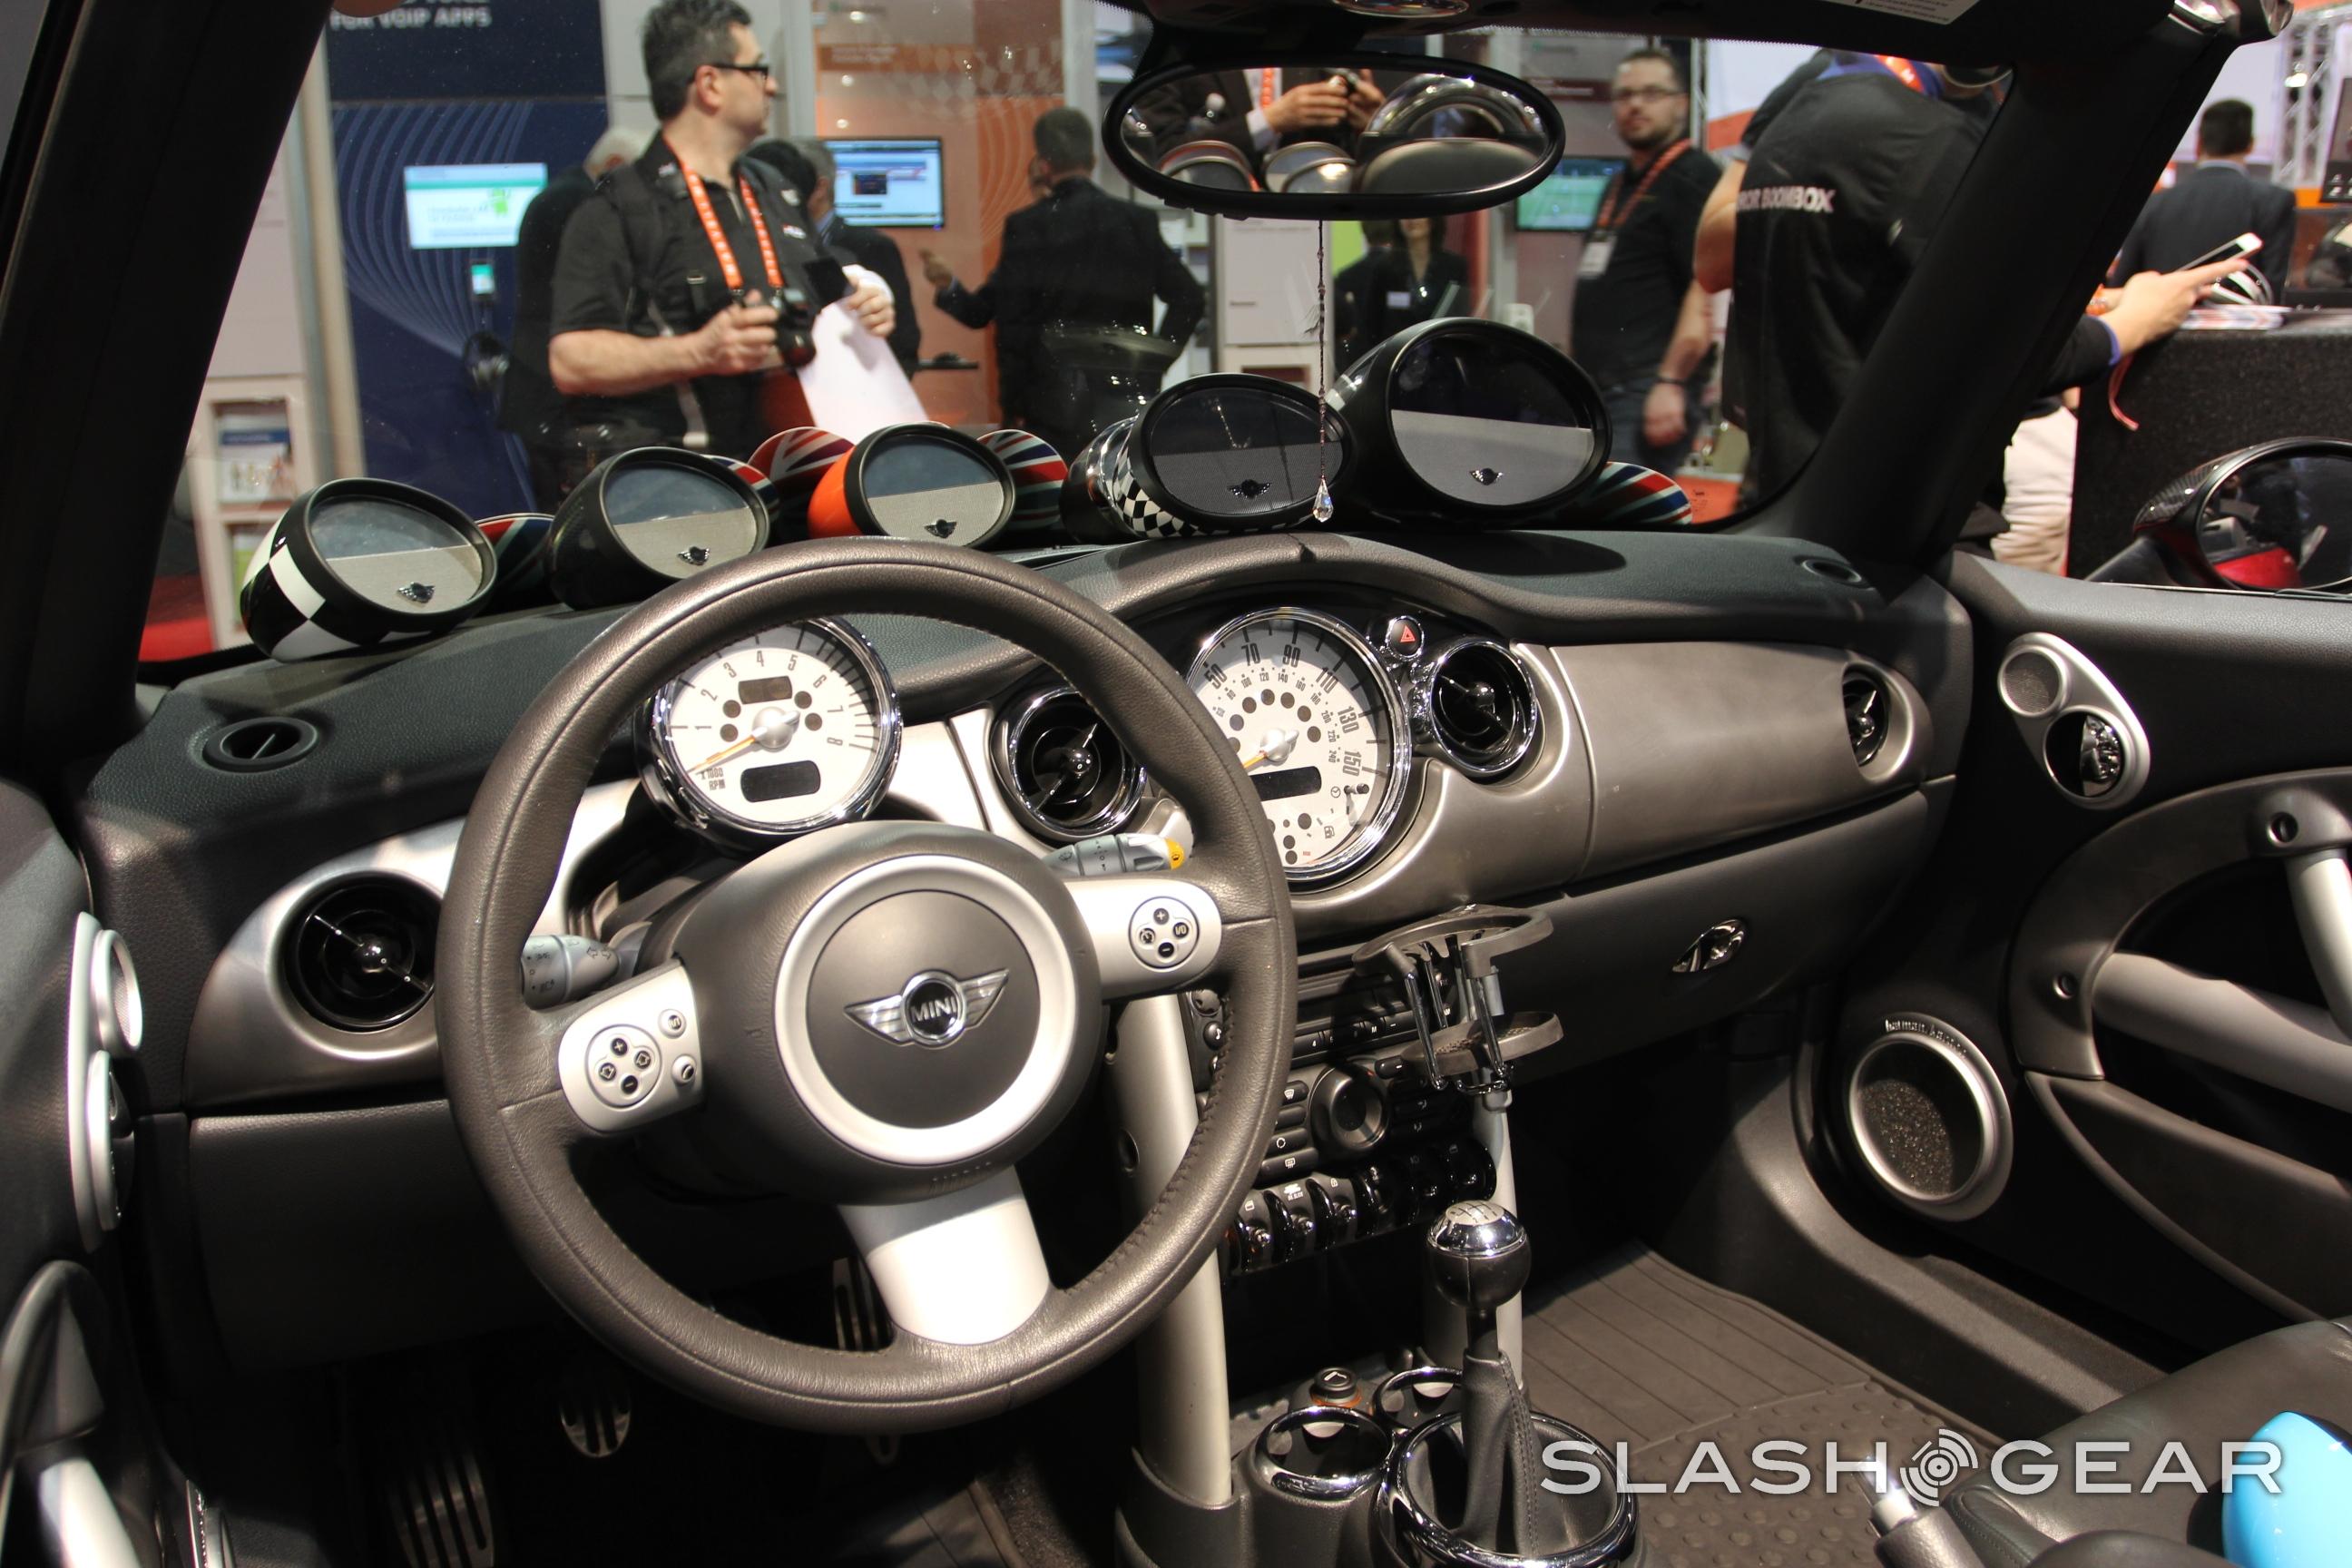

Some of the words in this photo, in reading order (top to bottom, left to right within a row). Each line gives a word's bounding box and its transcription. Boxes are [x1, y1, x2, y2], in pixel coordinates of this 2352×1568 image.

[434, 7, 493, 28] APPS
[757, 651, 764, 667] 4
[788, 654, 799, 671] 5
[1240, 642, 1261, 666] 70
[1282, 644, 1301, 668] 90
[723, 662, 737, 678] 3
[1204, 663, 1228, 690] 50
[813, 674, 827, 688] 6
[1316, 667, 1338, 694] 110
[701, 689, 718, 701] 2
[828, 705, 844, 713] 7
[1338, 706, 1359, 734] 130
[827, 737, 843, 746] 8
[1343, 750, 1362, 778] 150
[709, 779, 726, 790] RPM
[910, 995, 958, 1022] MINI
